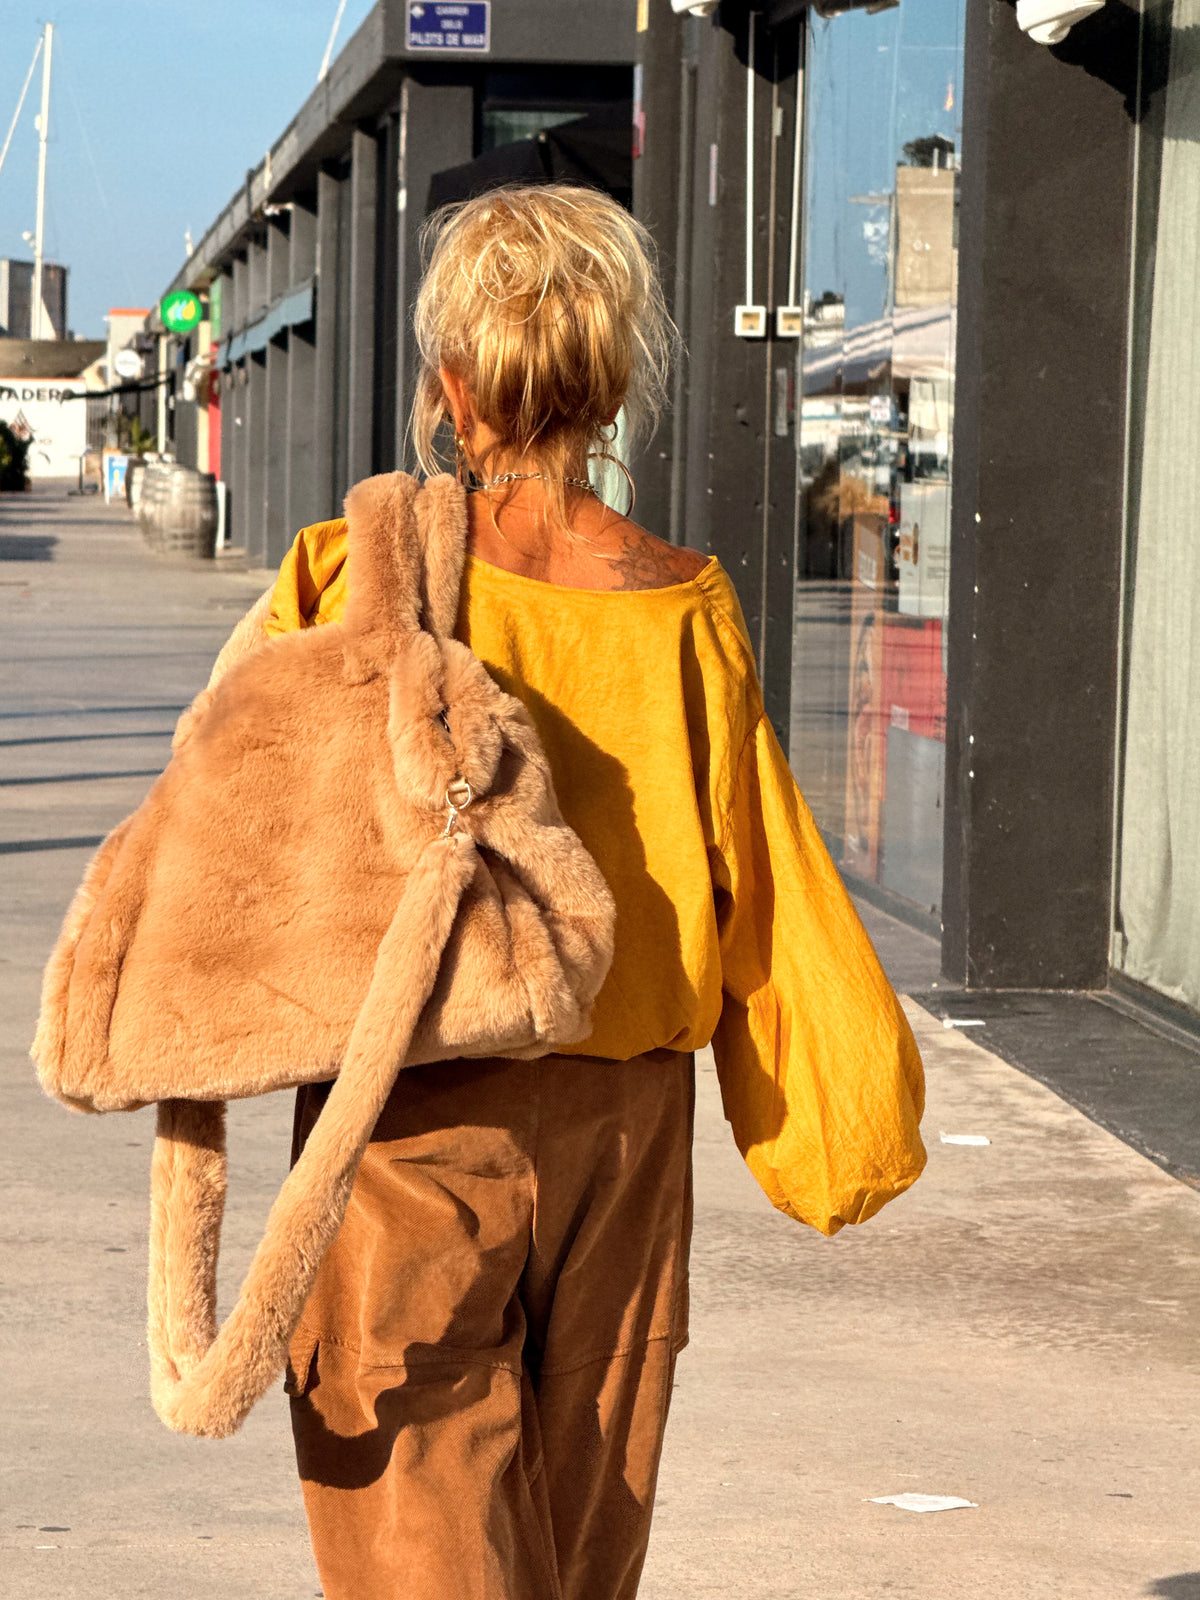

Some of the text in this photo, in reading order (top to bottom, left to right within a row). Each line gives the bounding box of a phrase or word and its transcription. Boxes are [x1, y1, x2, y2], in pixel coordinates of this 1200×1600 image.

[409, 32, 484, 46] PILOTS DE MAR
